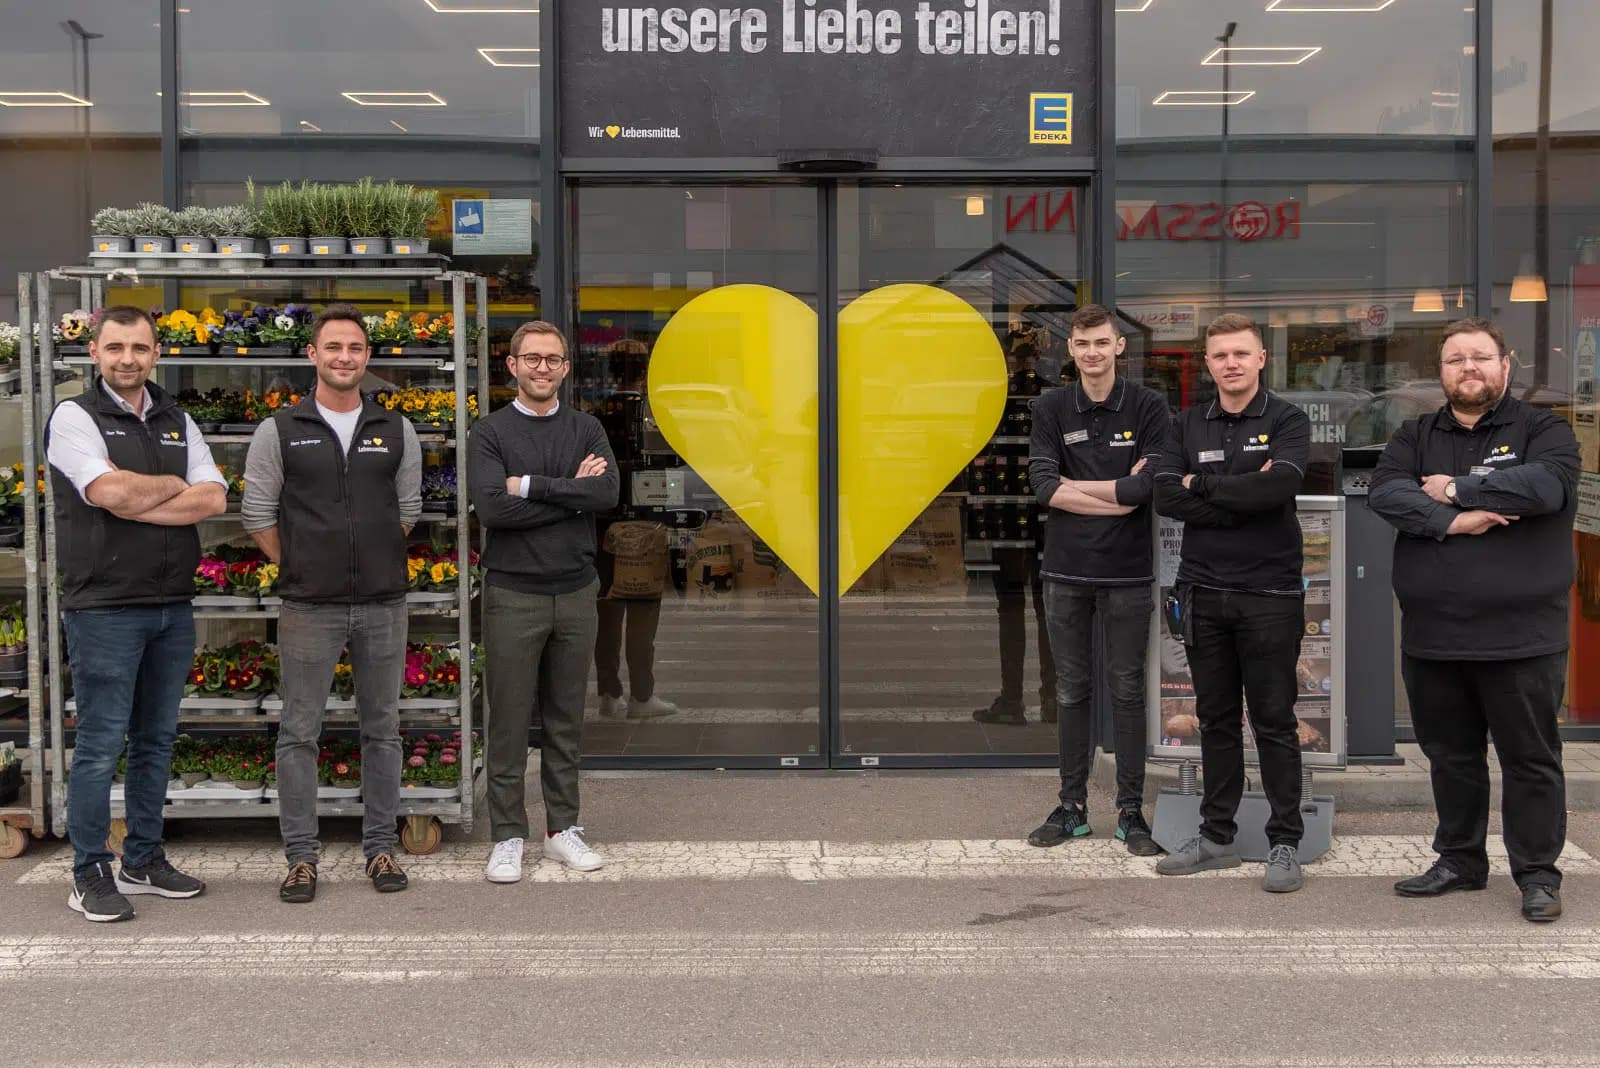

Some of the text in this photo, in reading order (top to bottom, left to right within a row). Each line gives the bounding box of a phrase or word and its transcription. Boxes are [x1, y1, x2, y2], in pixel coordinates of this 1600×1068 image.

[601, 0, 1061, 56] unsere Liebe teilen!
[588, 126, 681, 139] Wir Lebensmittel.
[1033, 133, 1069, 141] EDEKA
